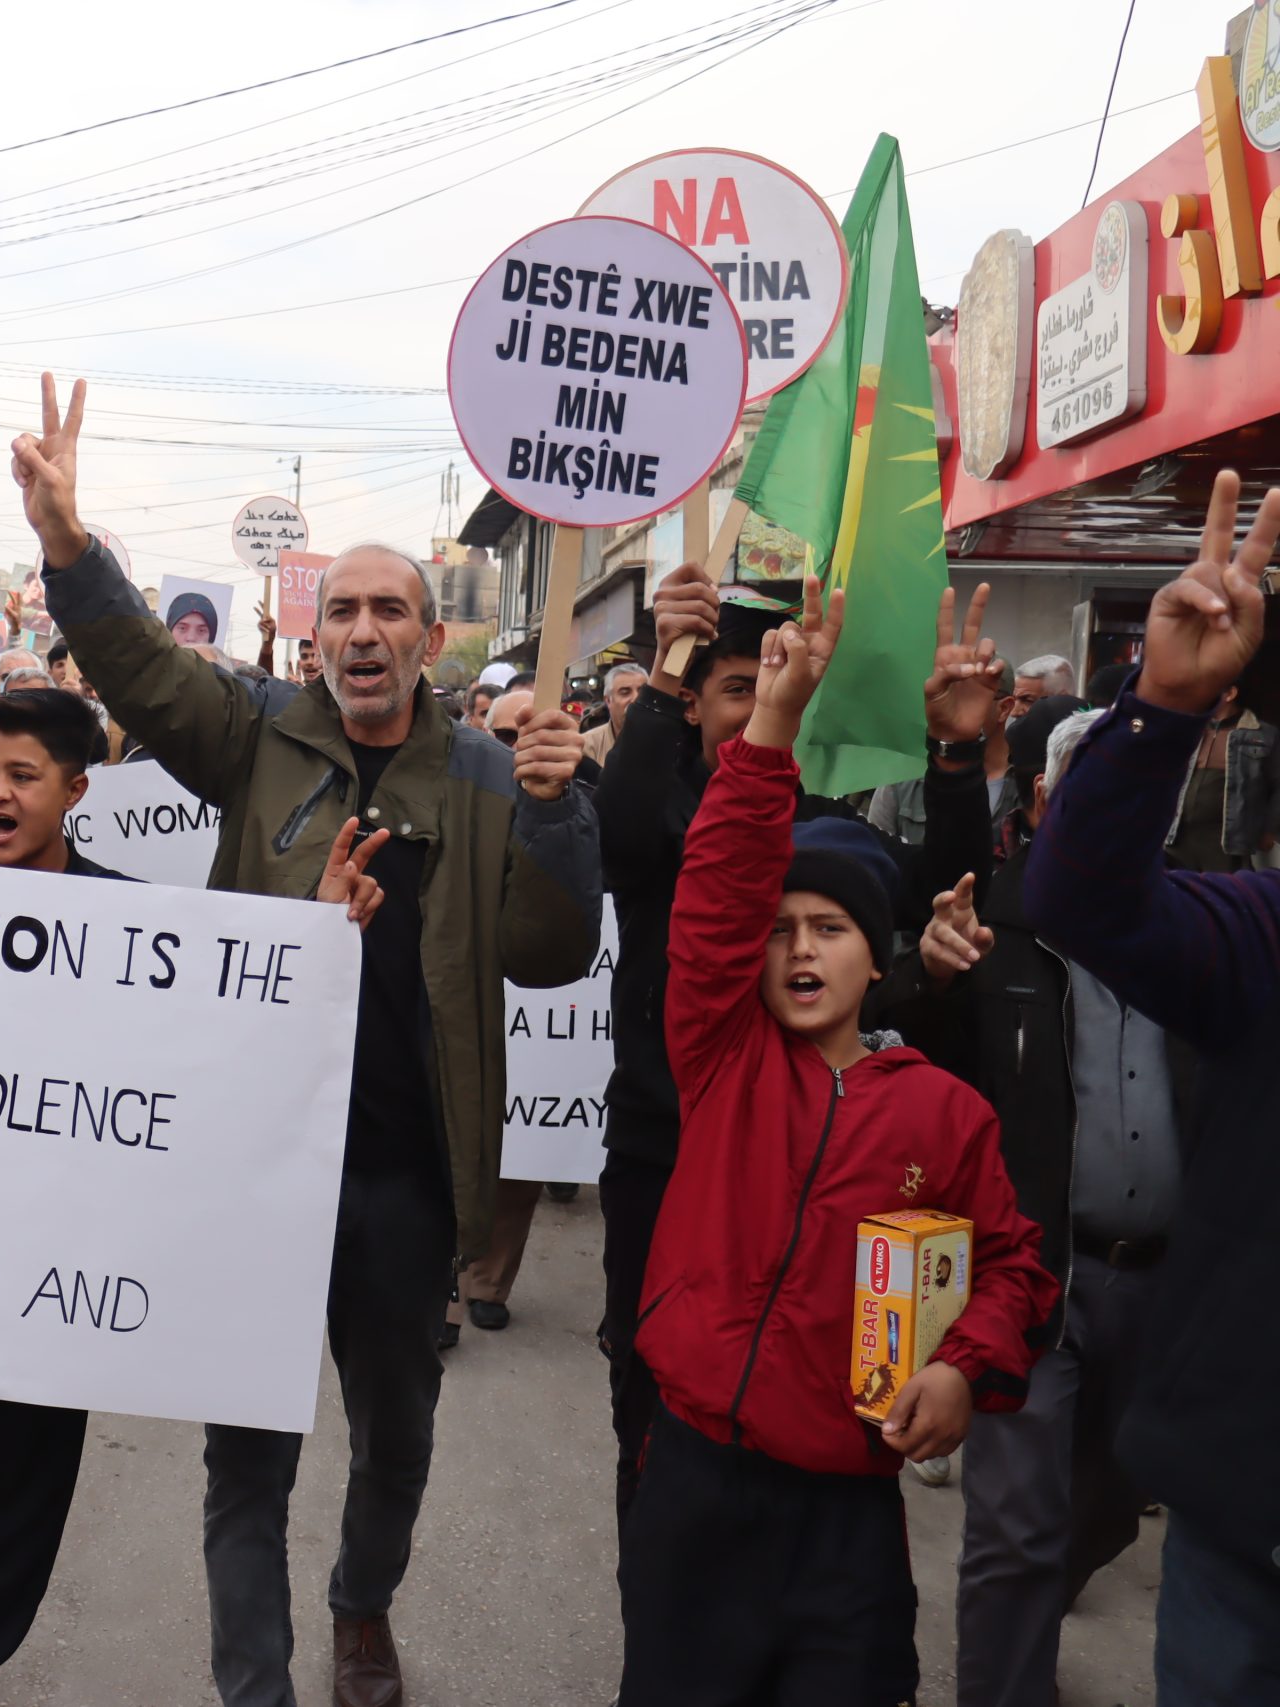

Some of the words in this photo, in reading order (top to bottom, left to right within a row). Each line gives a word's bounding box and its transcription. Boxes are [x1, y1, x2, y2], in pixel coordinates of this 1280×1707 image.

[653, 177, 750, 246] NA
[502, 259, 622, 316] DESTÊ
[629, 278, 713, 329] XWE
[496, 310, 532, 363] Jİ
[541, 324, 689, 385] BEDENA
[555, 378, 626, 434] MİN
[1051, 381, 1113, 434] 461096
[507, 430, 659, 499] BİKŞÎNE
[116, 926, 181, 990] IS
[218, 937, 303, 1005] THE
[874, 1241, 886, 1276] TURKO
[874, 1276, 884, 1291] AL
[921, 1247, 933, 1304] T-BAR
[21, 1266, 150, 1333] AND
[860, 1298, 880, 1372] T-BAR
